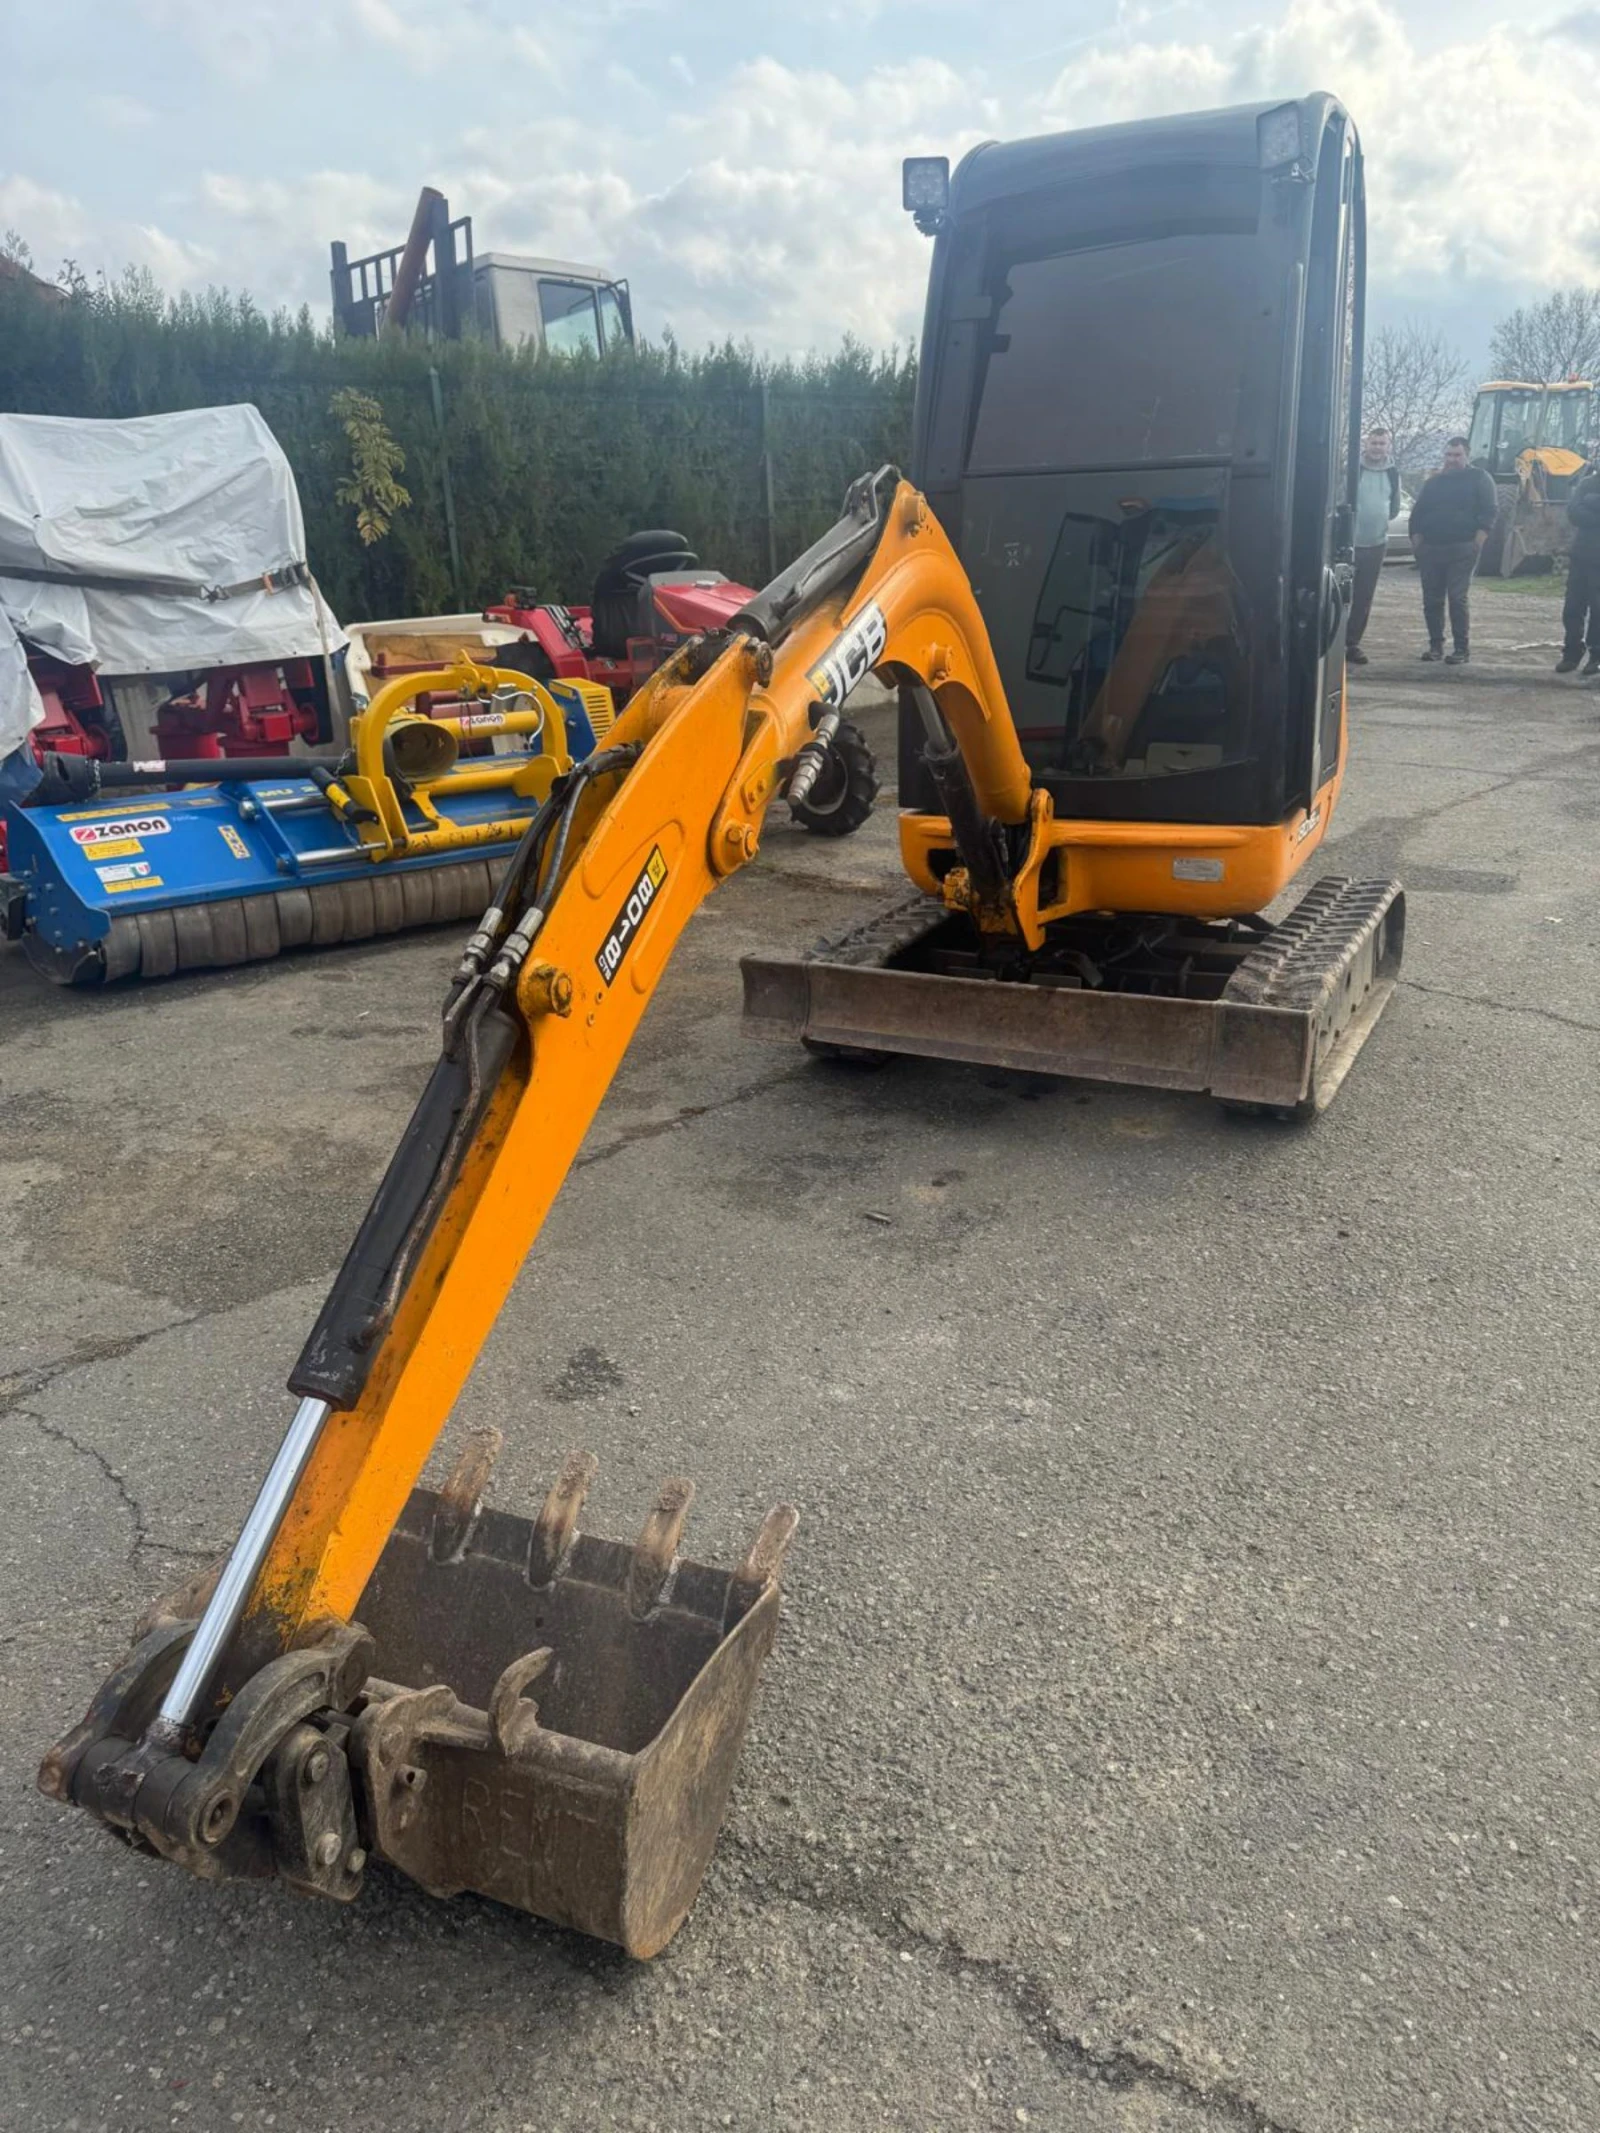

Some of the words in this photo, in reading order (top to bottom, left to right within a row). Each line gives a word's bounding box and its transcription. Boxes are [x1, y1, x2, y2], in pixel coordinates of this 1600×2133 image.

[824, 603, 887, 707] JCB
[96, 819, 166, 837] zanon
[604, 873, 654, 970] 8018
